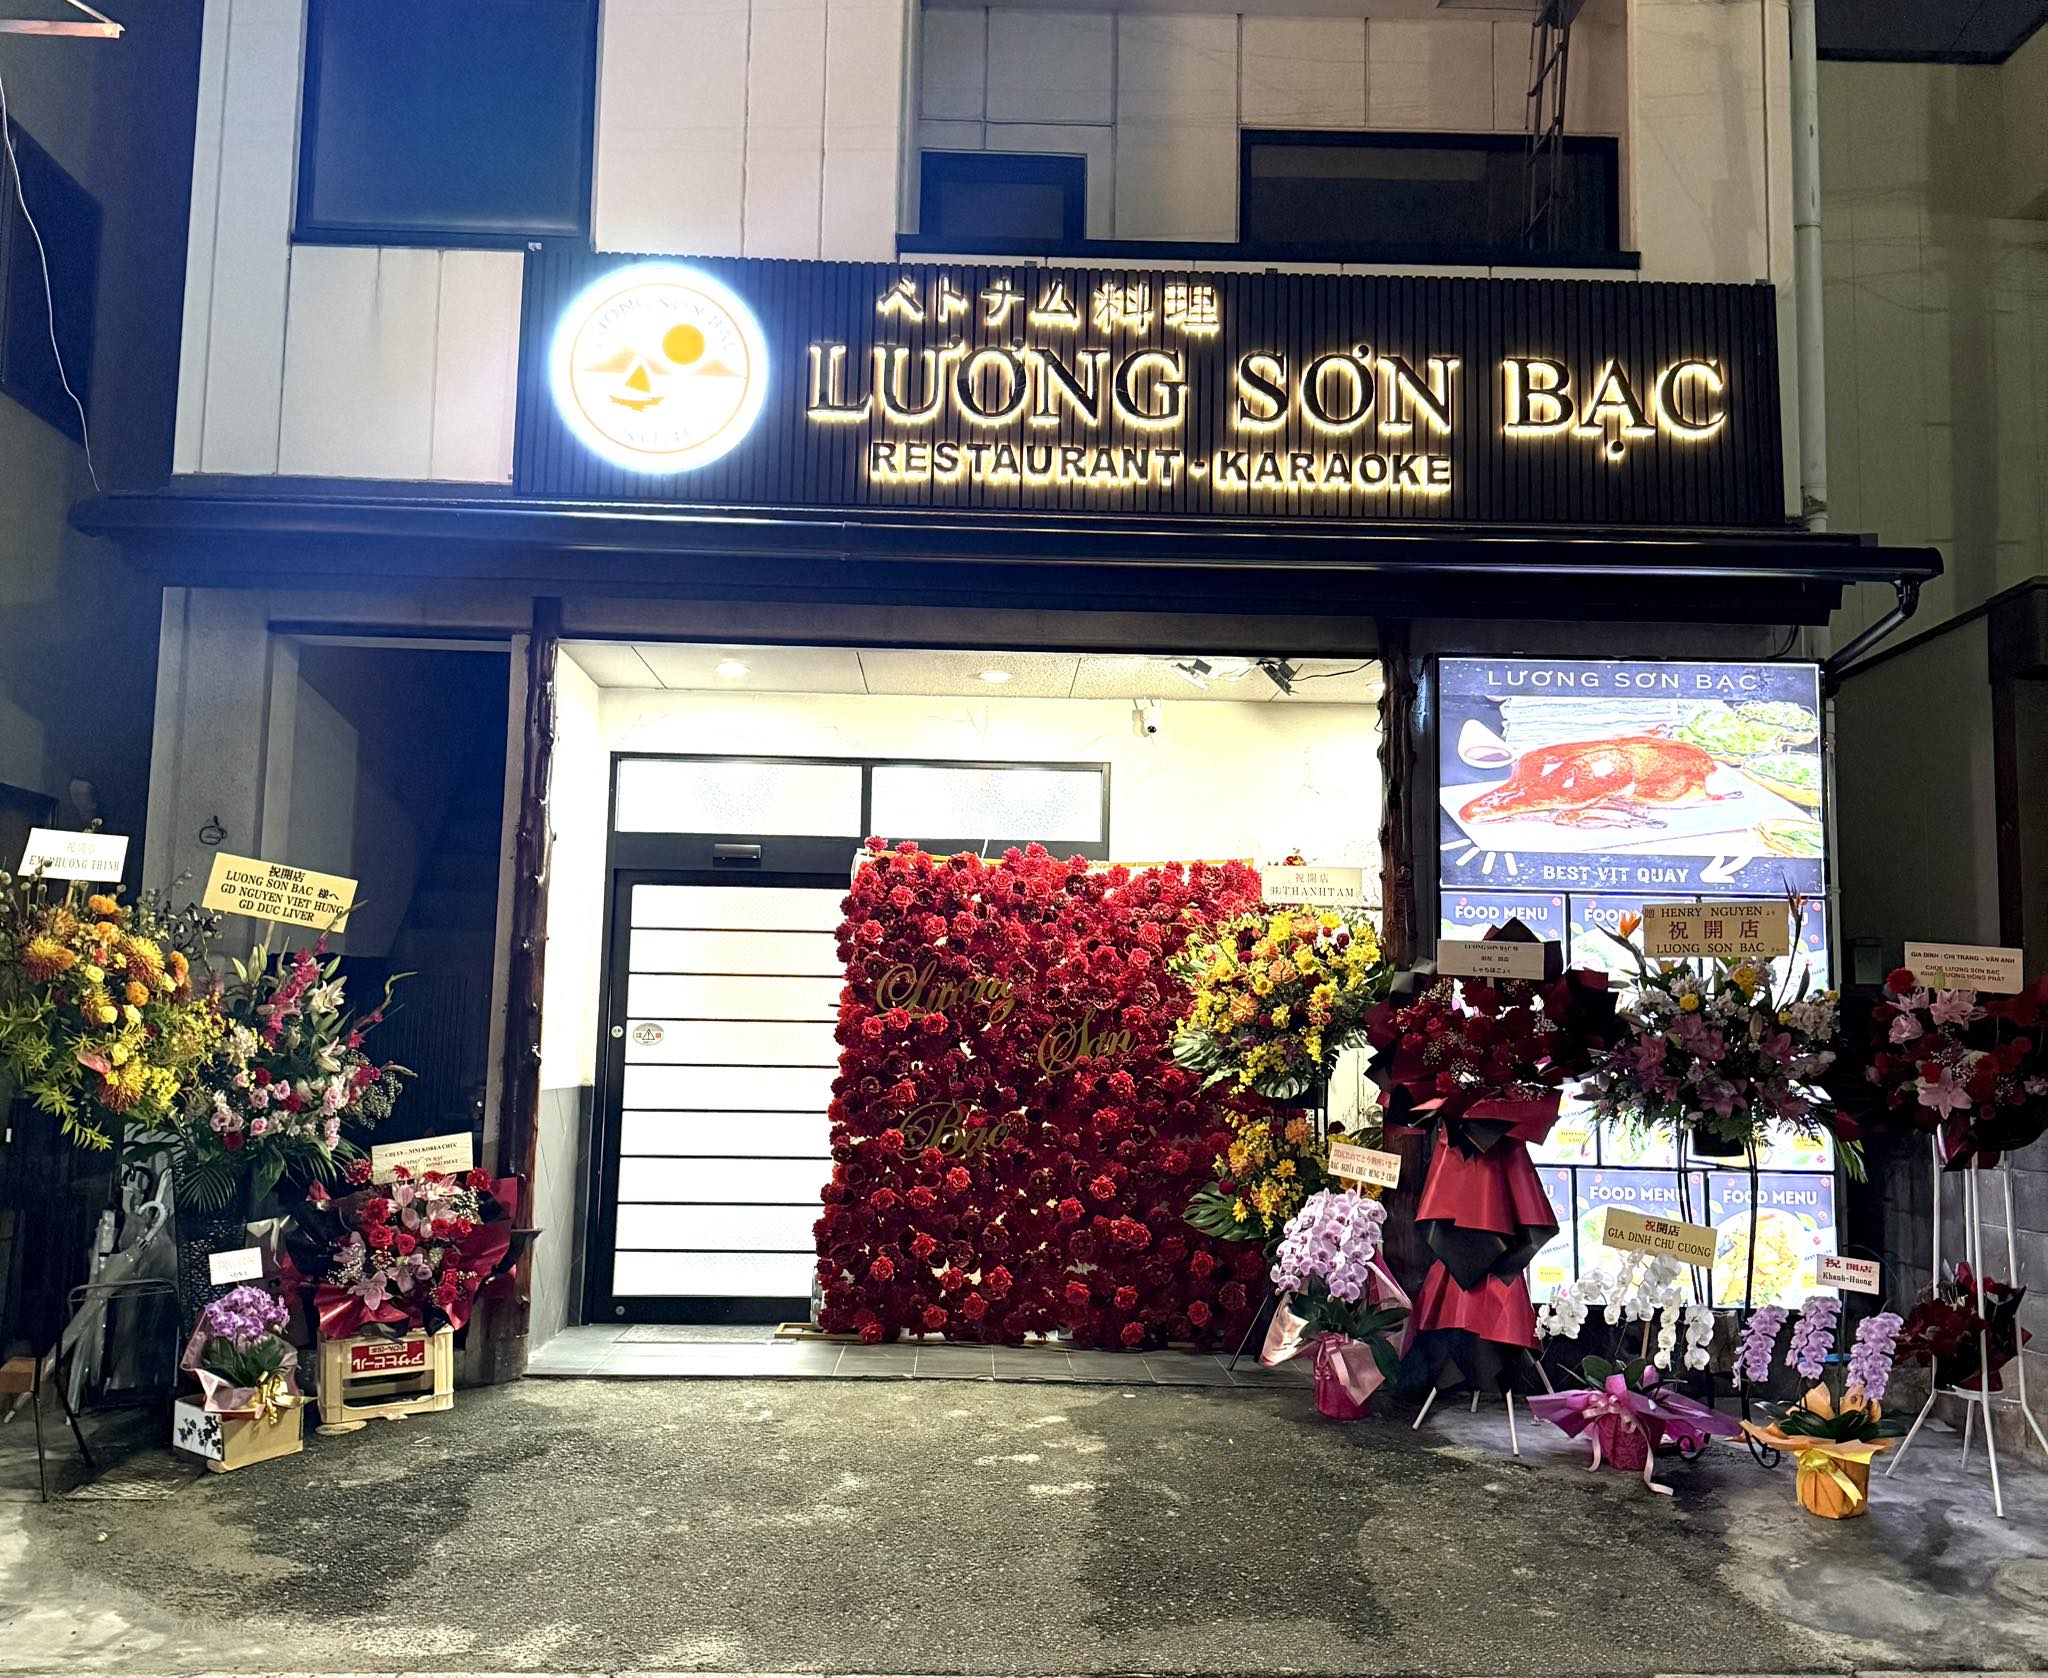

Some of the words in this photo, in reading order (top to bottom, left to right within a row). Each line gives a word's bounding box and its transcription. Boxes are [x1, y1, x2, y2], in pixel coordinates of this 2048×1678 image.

[876, 276, 1222, 333] ベトナム料理
[806, 335, 1190, 426] LƯƠNG
[1237, 343, 1461, 433] SƠN
[1502, 358, 1728, 461] BẠC
[1487, 669, 1601, 689] LƯƠNG
[1614, 671, 1681, 690] SƠN
[1696, 673, 1760, 693] BẠC
[225, 870, 264, 887] LUONG
[265, 878, 290, 892] SON
[291, 884, 314, 897] BAC
[268, 865, 306, 884] 祝開店
[1542, 865, 1594, 882] BEST
[1596, 866, 1630, 885] VỊT
[1636, 866, 1690, 884] QUAY
[220, 883, 237, 895] GD
[238, 886, 284, 904] NGUYEN
[287, 895, 313, 910] VIET
[313, 900, 344, 915] HUNG
[238, 899, 255, 911] GD
[256, 903, 281, 916] DUC
[282, 907, 315, 923] LIVER
[1455, 905, 1500, 920] FOOD
[1503, 906, 1549, 921] MENU
[1660, 907, 1703, 918] HENRY
[1710, 905, 1763, 918] NGUYEN
[1667, 918, 1761, 941] 祝開店
[1655, 943, 1701, 954] LUONG
[1707, 943, 1734, 954] SON
[1739, 942, 1766, 954] BAC
[1956, 954, 1980, 963] TRANG
[1589, 1185, 1637, 1201] FOOD
[1722, 1188, 1769, 1204] FOOD
[1771, 1190, 1818, 1206] MENU
[1644, 1219, 1681, 1237] 祝開店
[1607, 1226, 1625, 1240] GIA
[1627, 1231, 1652, 1246] DINH
[1653, 1236, 1676, 1249] CHU
[1677, 1241, 1712, 1258] CUONG
[1822, 1271, 1873, 1287] Khanh-Huong
[352, 1350, 424, 1371] アサヒビール
